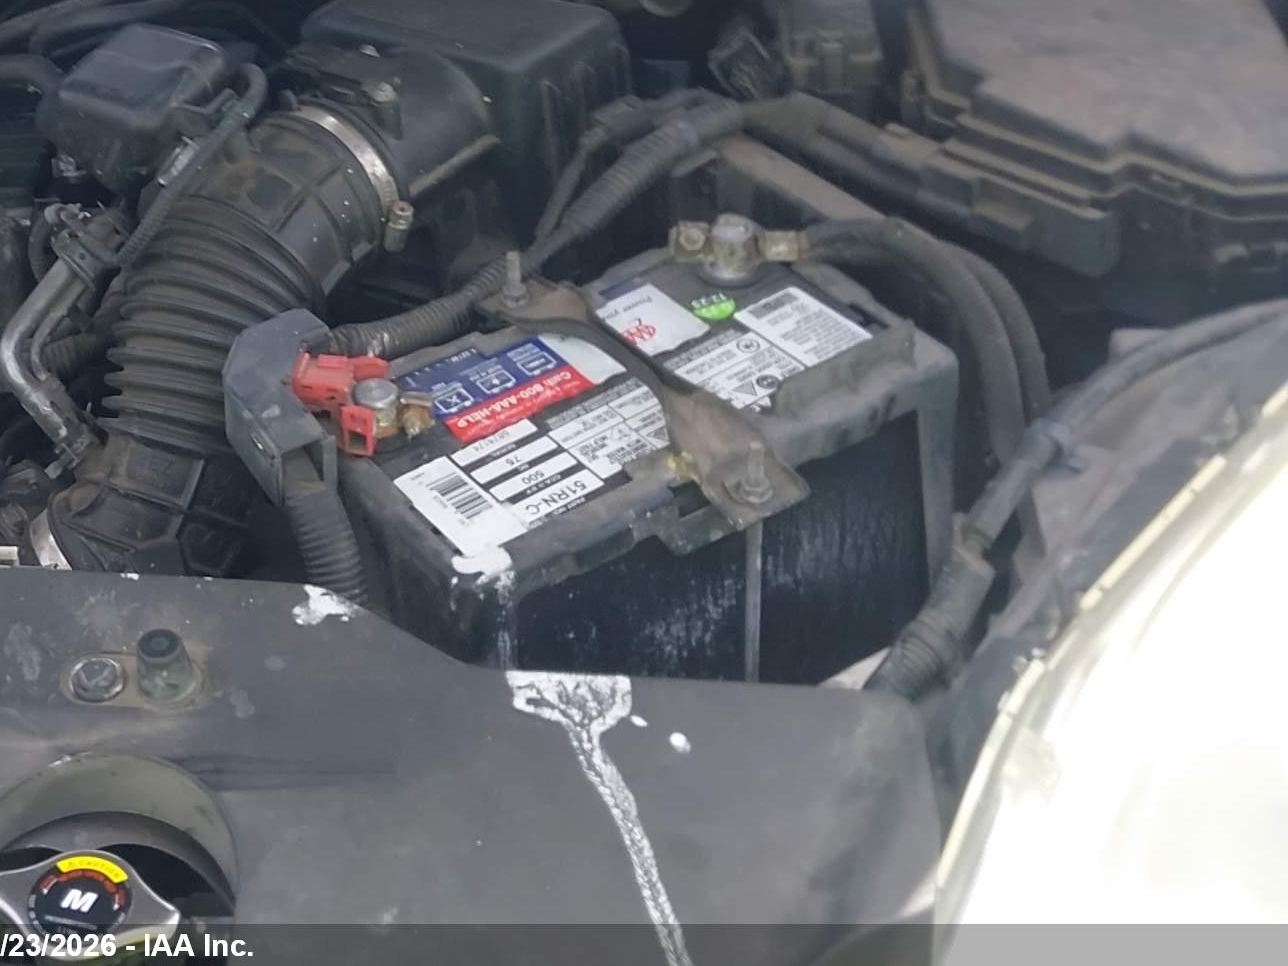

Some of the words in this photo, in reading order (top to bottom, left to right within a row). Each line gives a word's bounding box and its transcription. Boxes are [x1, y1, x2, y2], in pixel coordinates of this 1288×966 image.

[457, 382, 544, 427] 800-AAA-HELP
[505, 455, 522, 466] 75
[521, 470, 545, 485] 500
[525, 481, 586, 515] 51RN-C
[60, 888, 99, 913] M
